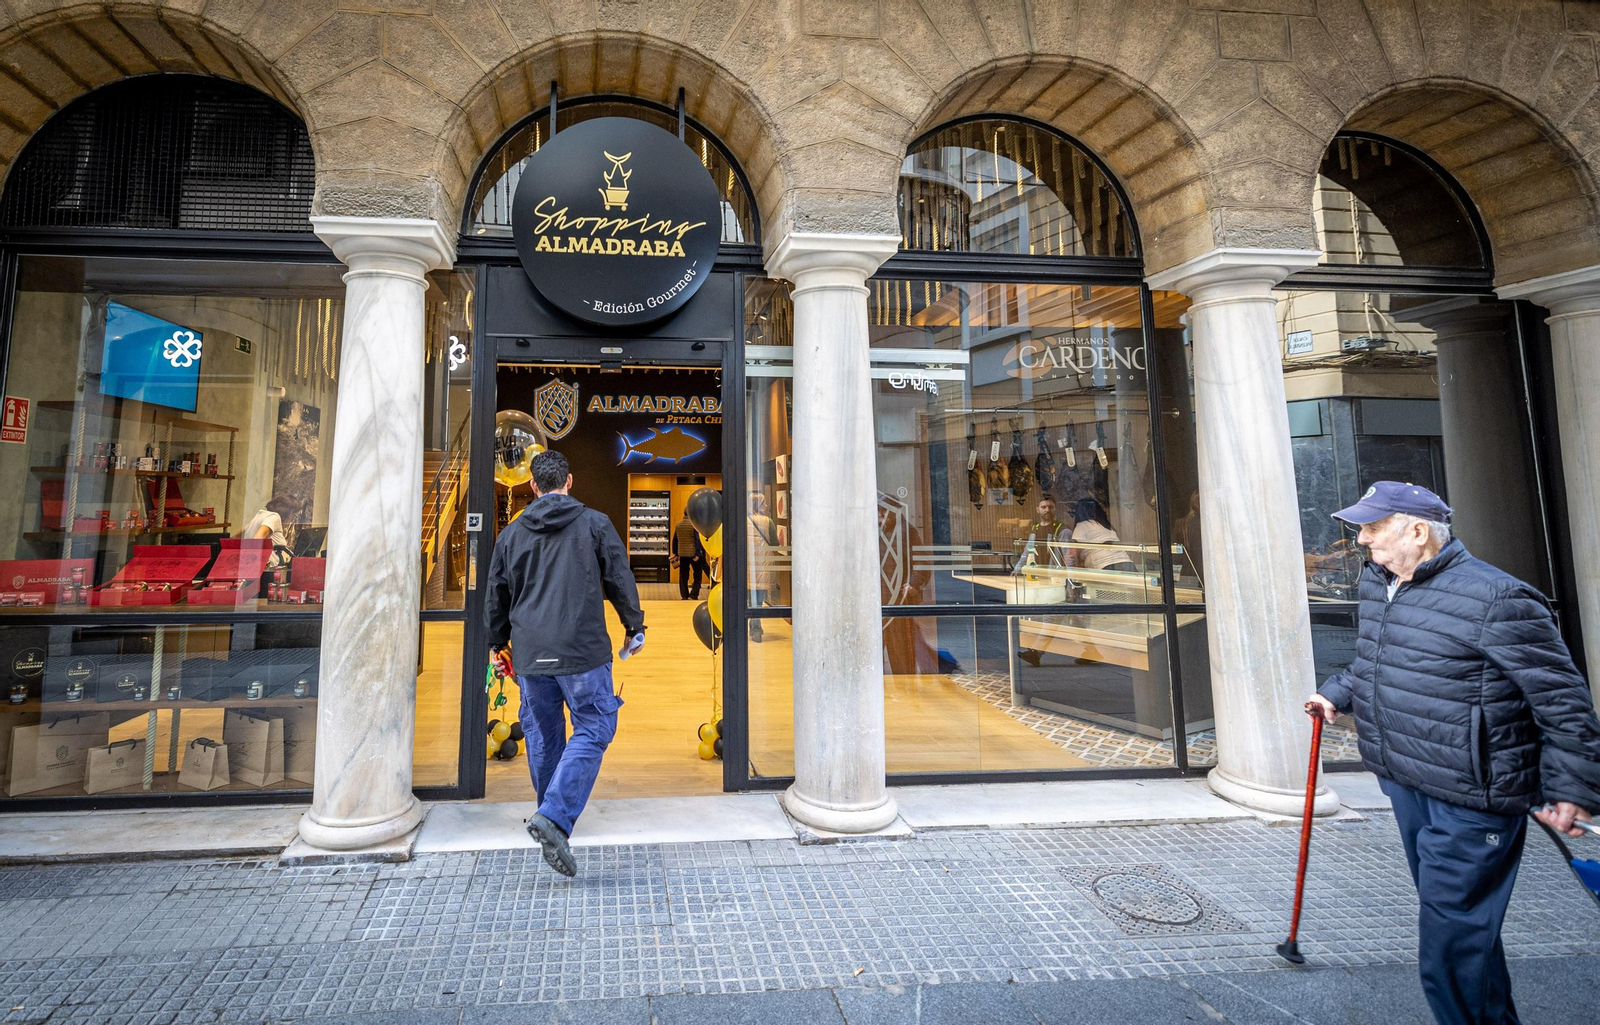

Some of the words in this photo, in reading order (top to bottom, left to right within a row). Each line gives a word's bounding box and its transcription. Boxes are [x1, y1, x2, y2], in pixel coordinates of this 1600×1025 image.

[534, 197, 707, 240] Shopping
[535, 236, 685, 257] ALMADRABA
[592, 300, 645, 315] Edición
[646, 268, 696, 308] Gourmet
[1058, 337, 1109, 345] HERMANOS
[2, 430, 25, 440] EXTINTOR
